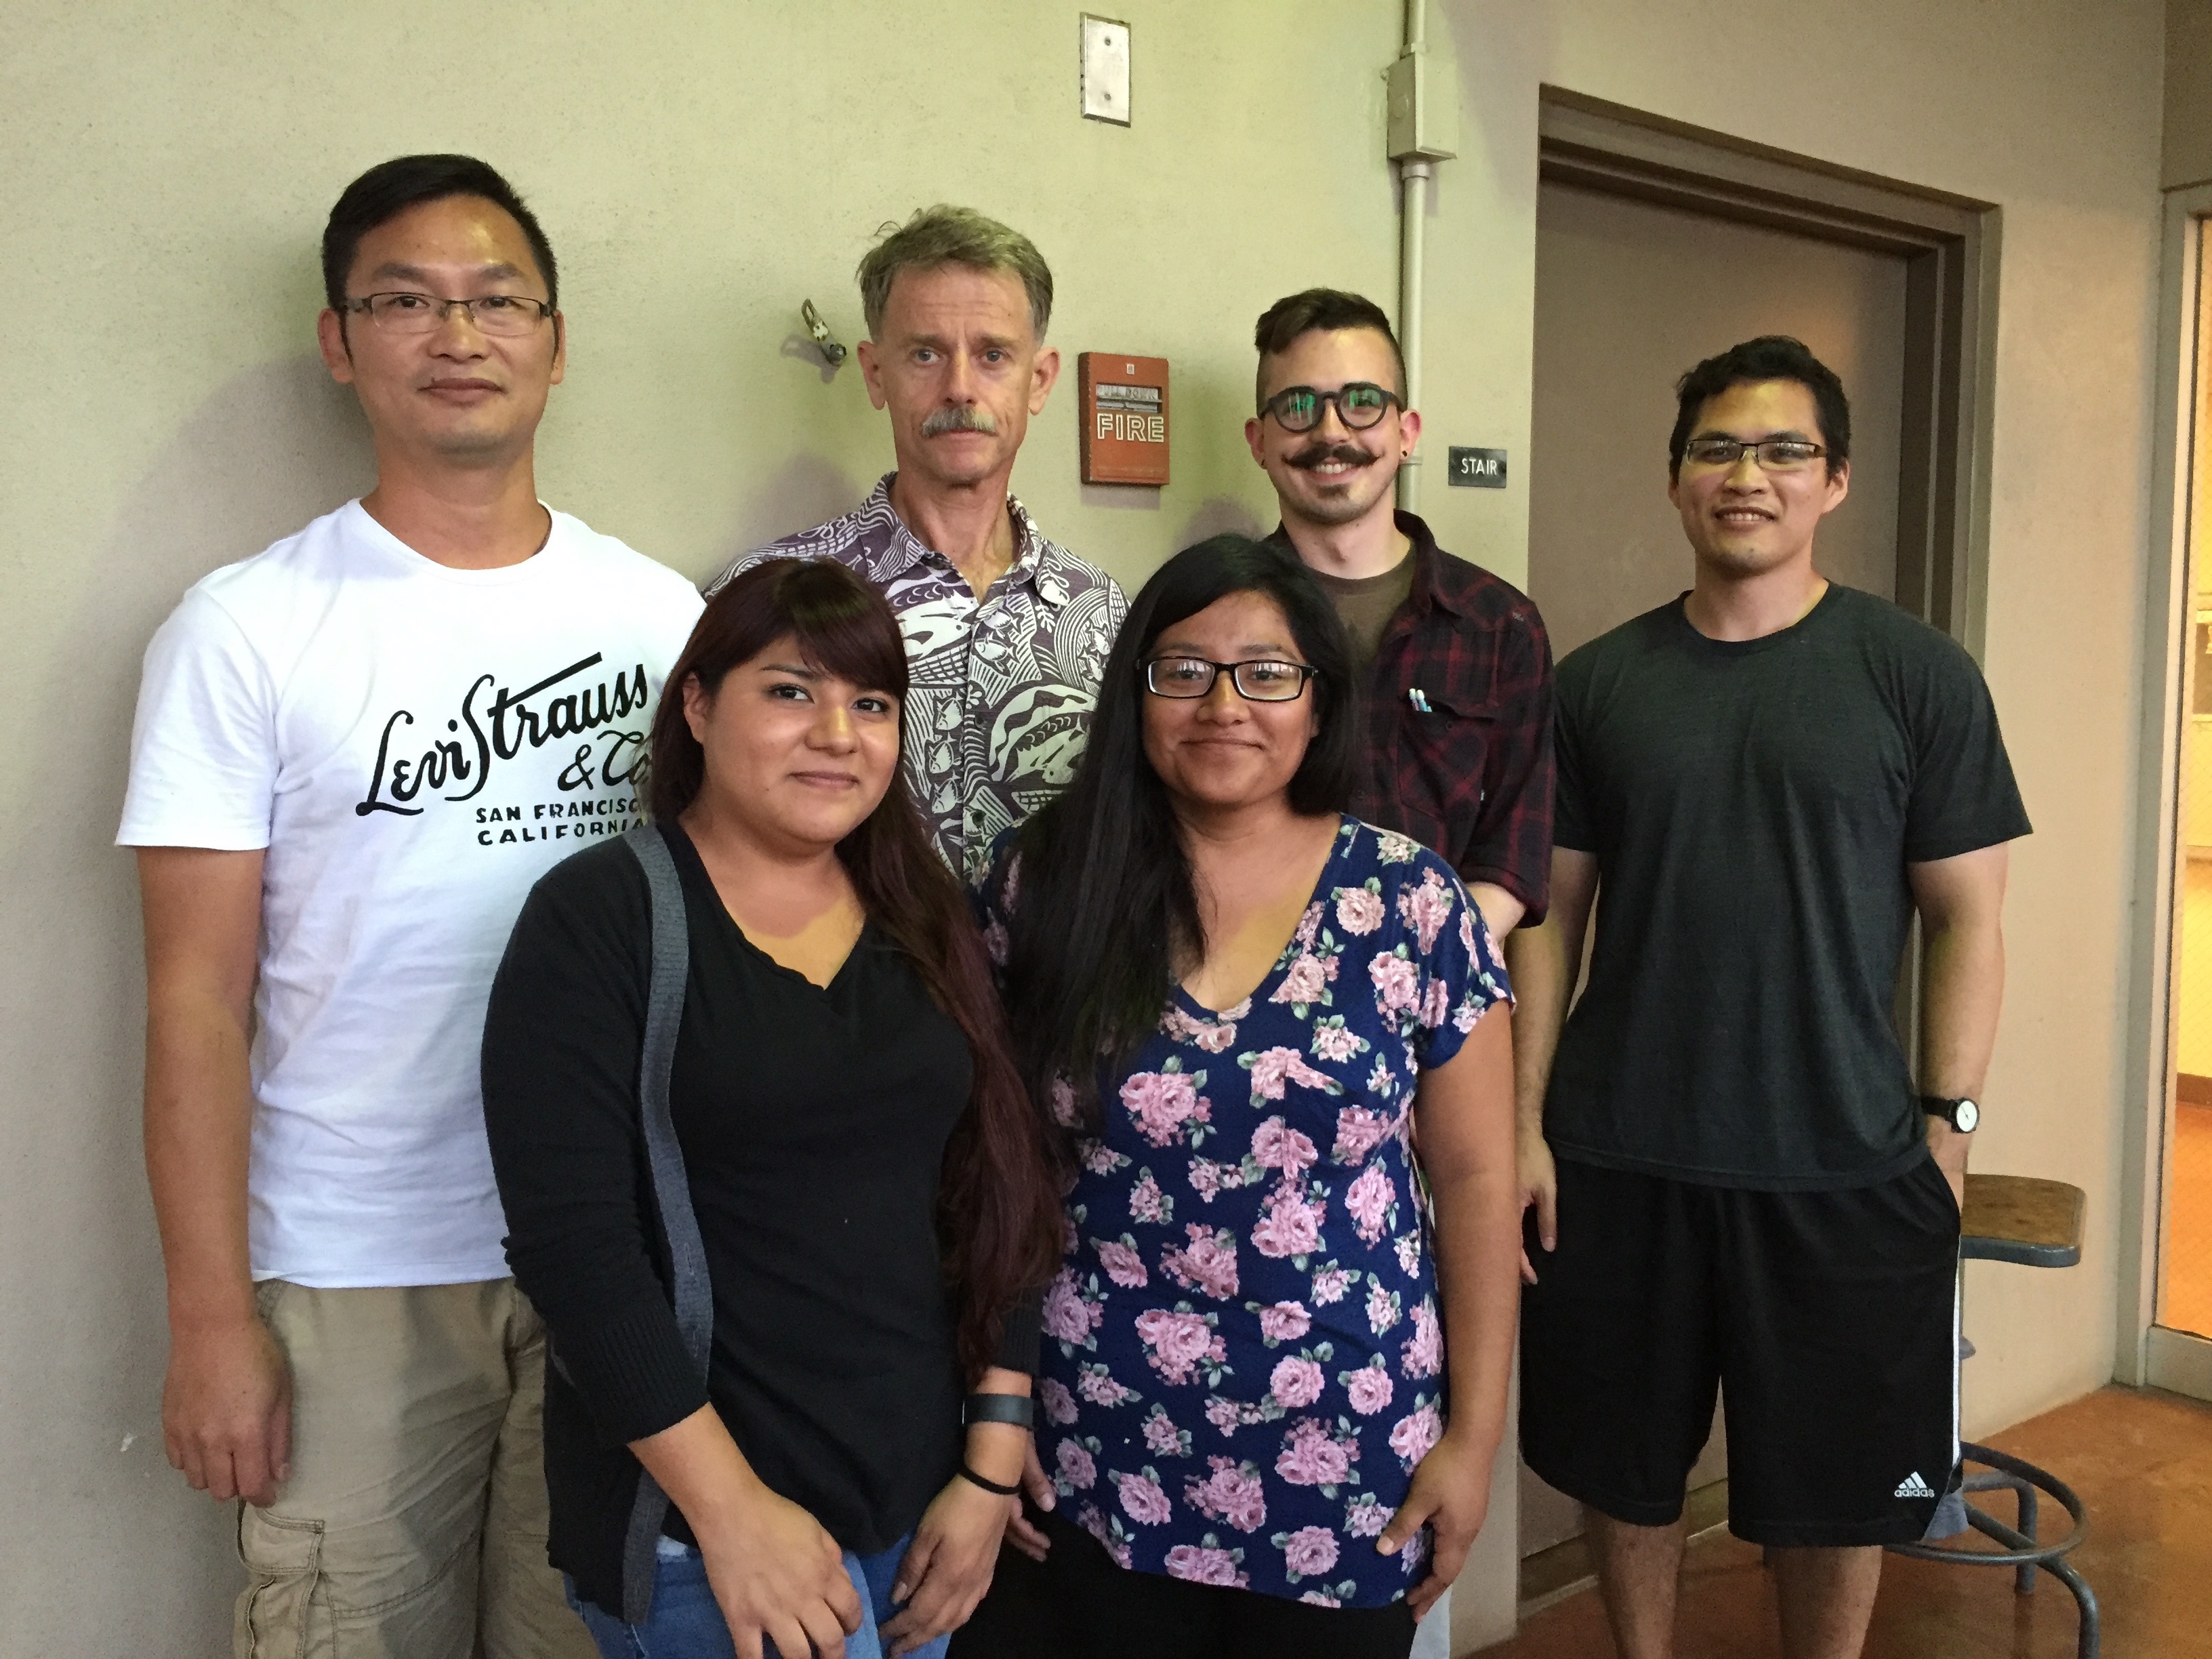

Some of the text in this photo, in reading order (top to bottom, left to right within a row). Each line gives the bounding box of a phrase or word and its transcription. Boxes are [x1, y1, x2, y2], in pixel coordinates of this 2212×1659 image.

[1097, 413, 1164, 443] FIRE
[1460, 457, 1497, 475] STAIR
[557, 743, 596, 792] &
[476, 798, 641, 823] SAN FRANCISC
[1894, 1487, 1935, 1498] adidas
